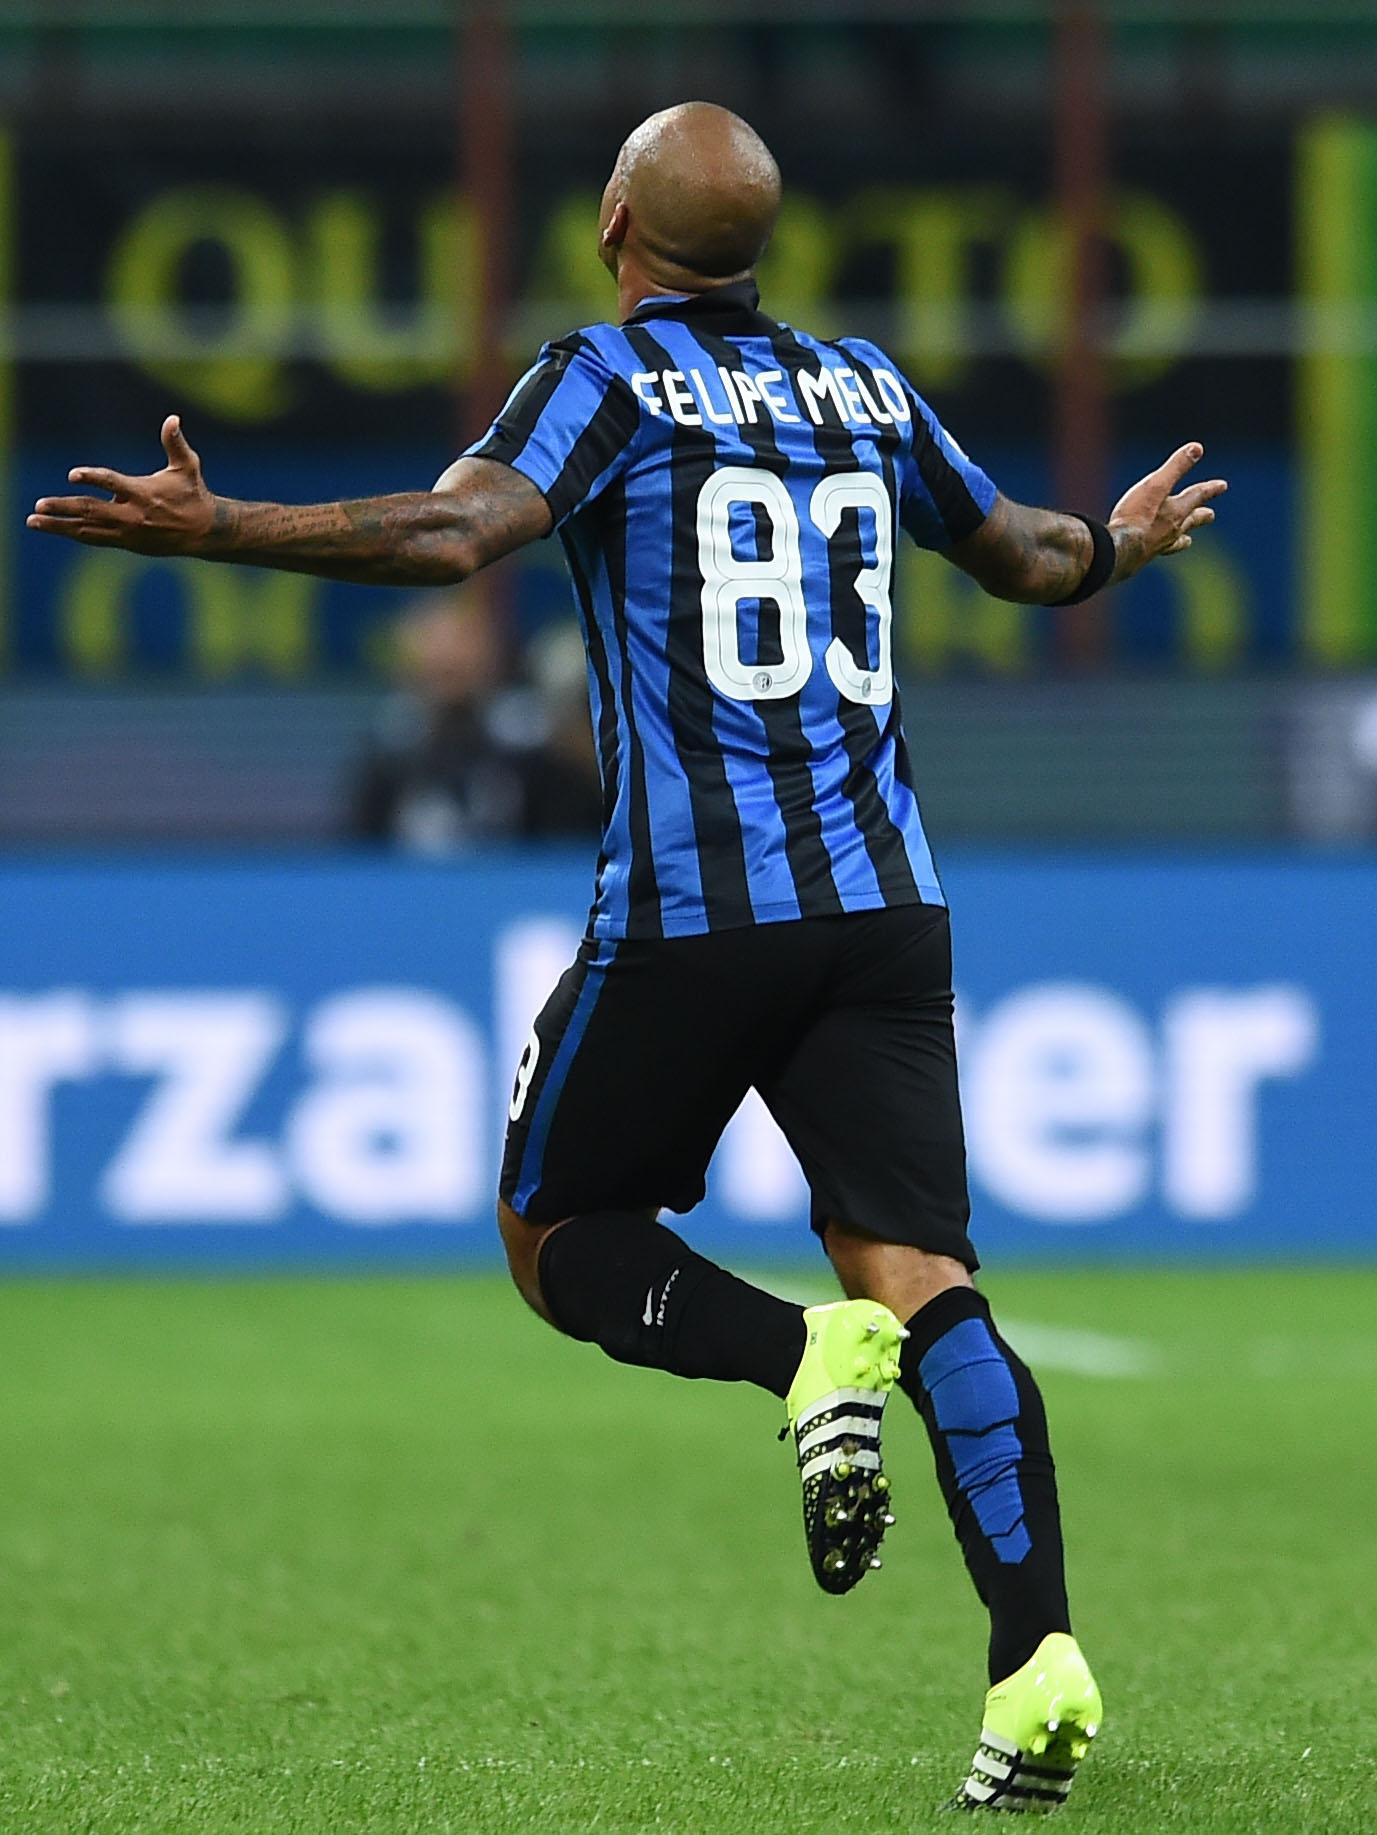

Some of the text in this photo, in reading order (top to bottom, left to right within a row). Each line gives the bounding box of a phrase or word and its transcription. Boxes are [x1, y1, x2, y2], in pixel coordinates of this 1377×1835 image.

[631, 366, 911, 426] FELIPE MELO
[696, 466, 893, 706] 83
